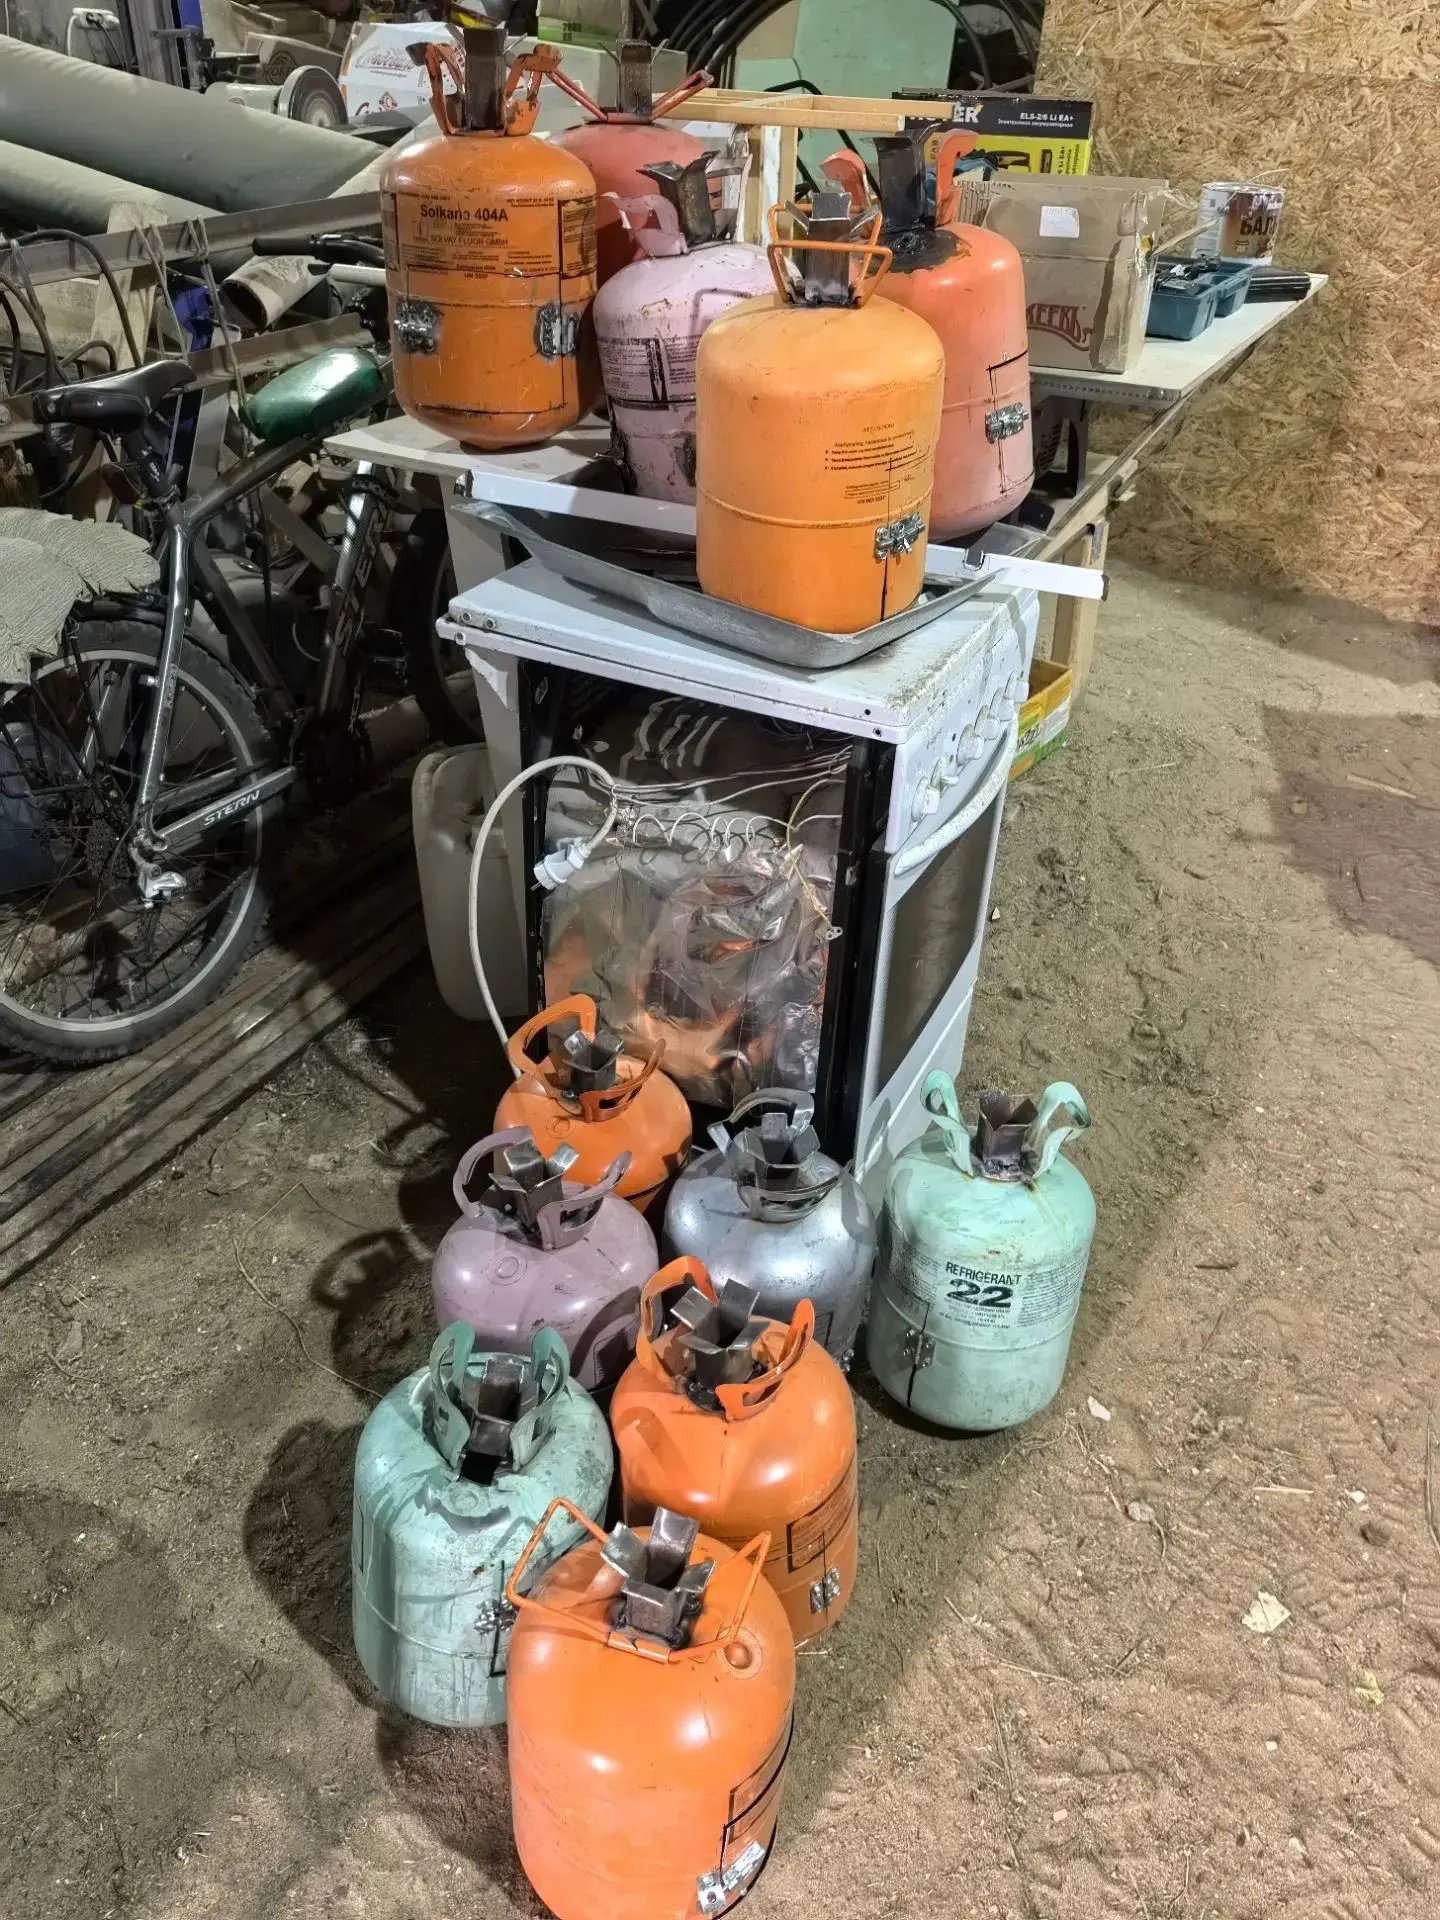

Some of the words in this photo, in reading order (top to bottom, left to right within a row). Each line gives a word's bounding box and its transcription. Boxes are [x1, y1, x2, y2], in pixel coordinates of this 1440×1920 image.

[474, 208, 508, 222] 404A
[203, 790, 260, 827] STERN
[945, 1261, 1022, 1285] REFRIGERANT
[946, 1278, 1014, 1308] 22
